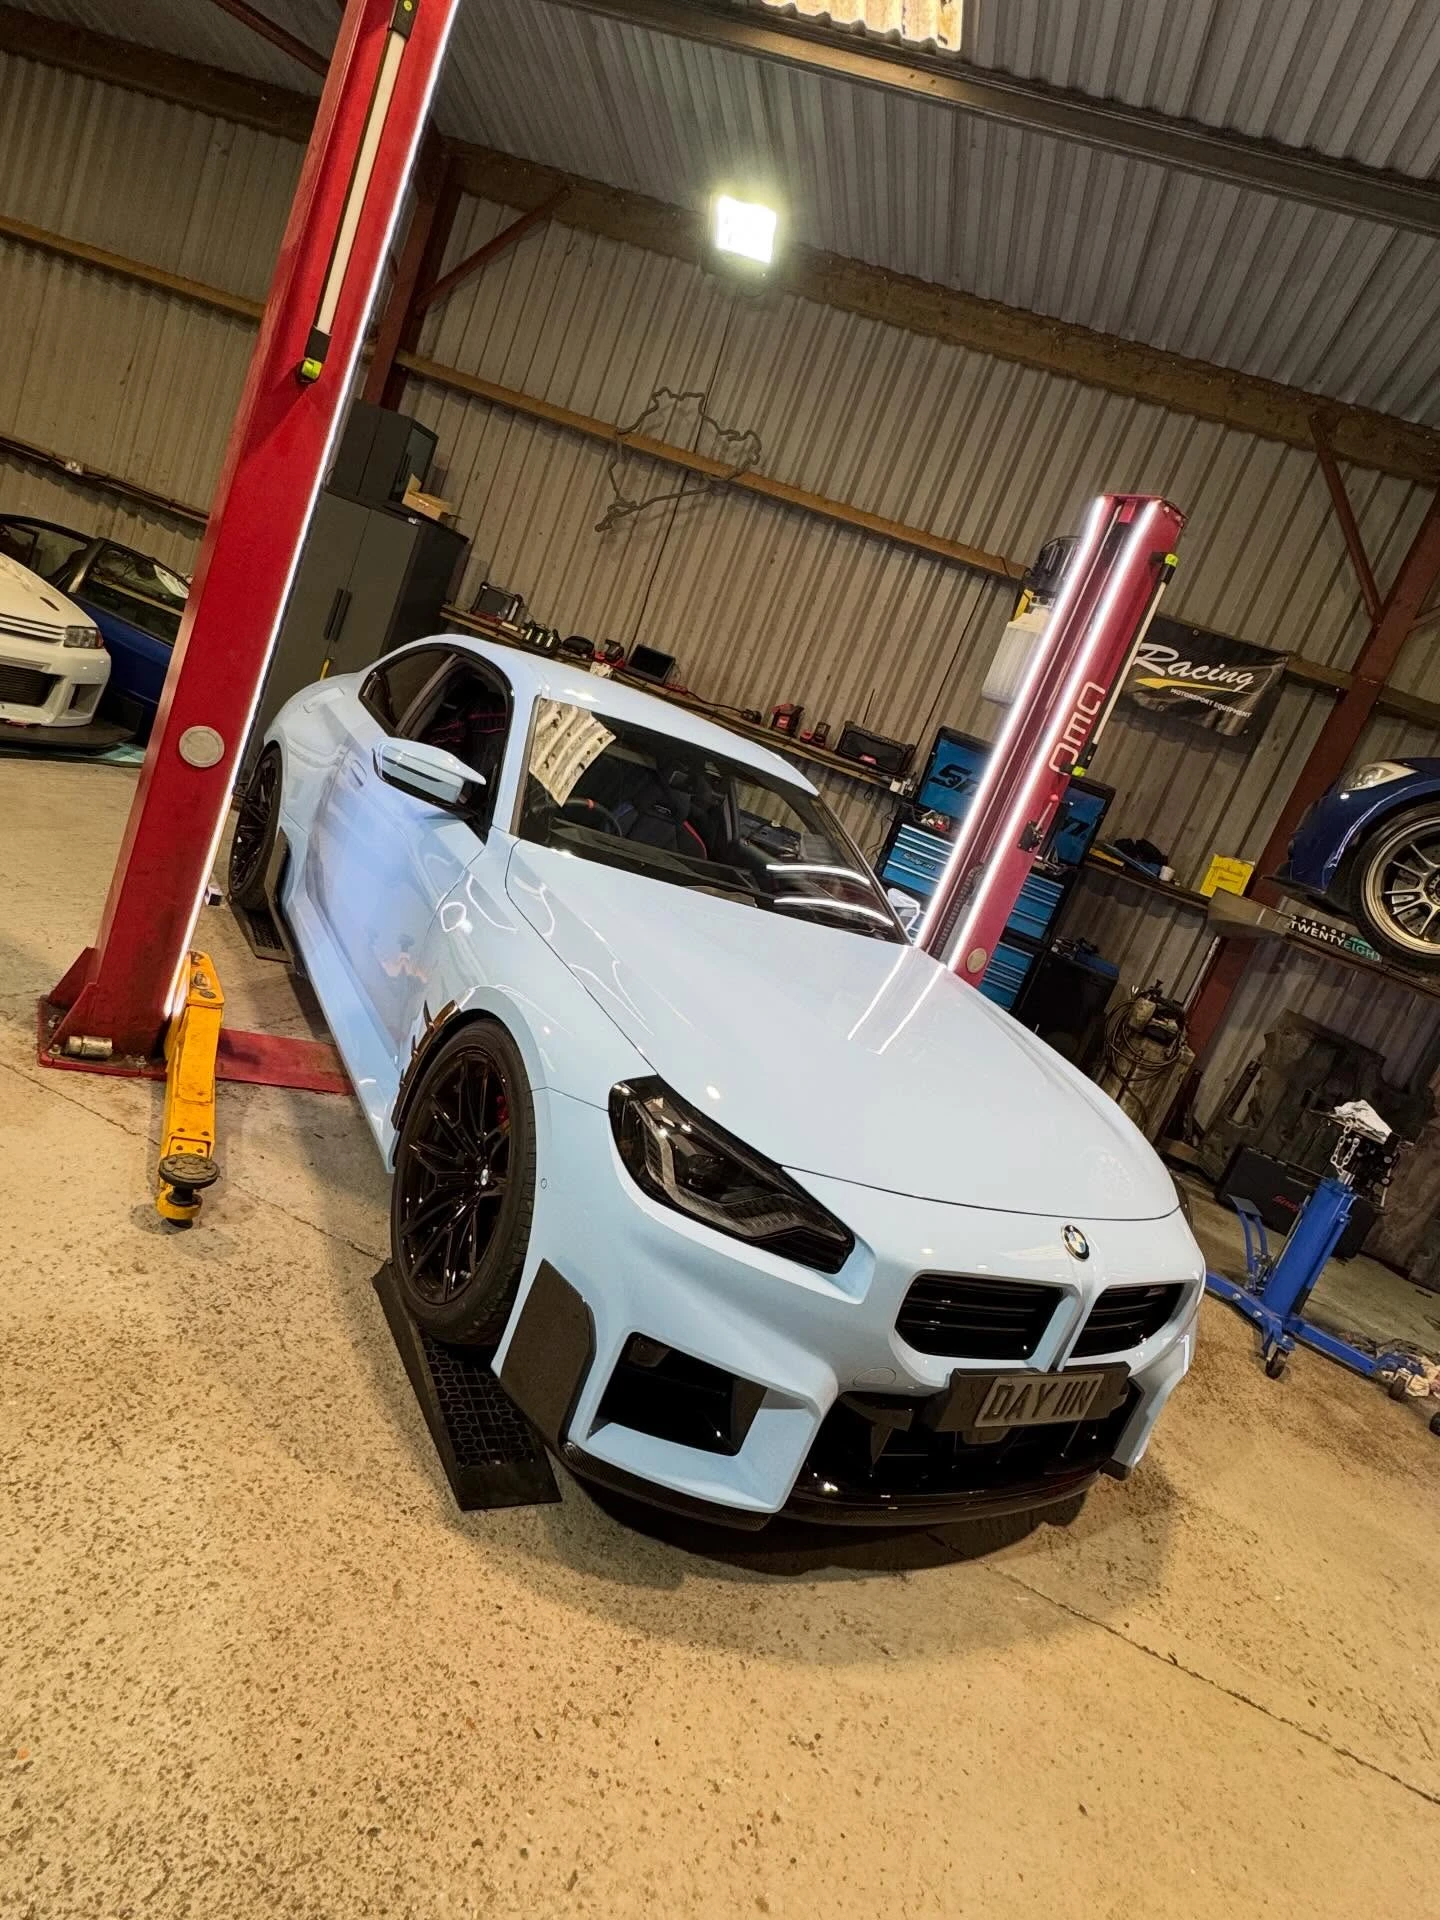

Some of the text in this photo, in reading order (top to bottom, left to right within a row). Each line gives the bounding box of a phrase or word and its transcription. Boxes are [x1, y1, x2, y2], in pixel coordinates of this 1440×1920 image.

[1132, 642, 1254, 692] Racing
[1170, 688, 1252, 718] MOTORSPORT EQUIPMENT
[982, 1383, 1058, 1421] DAY
